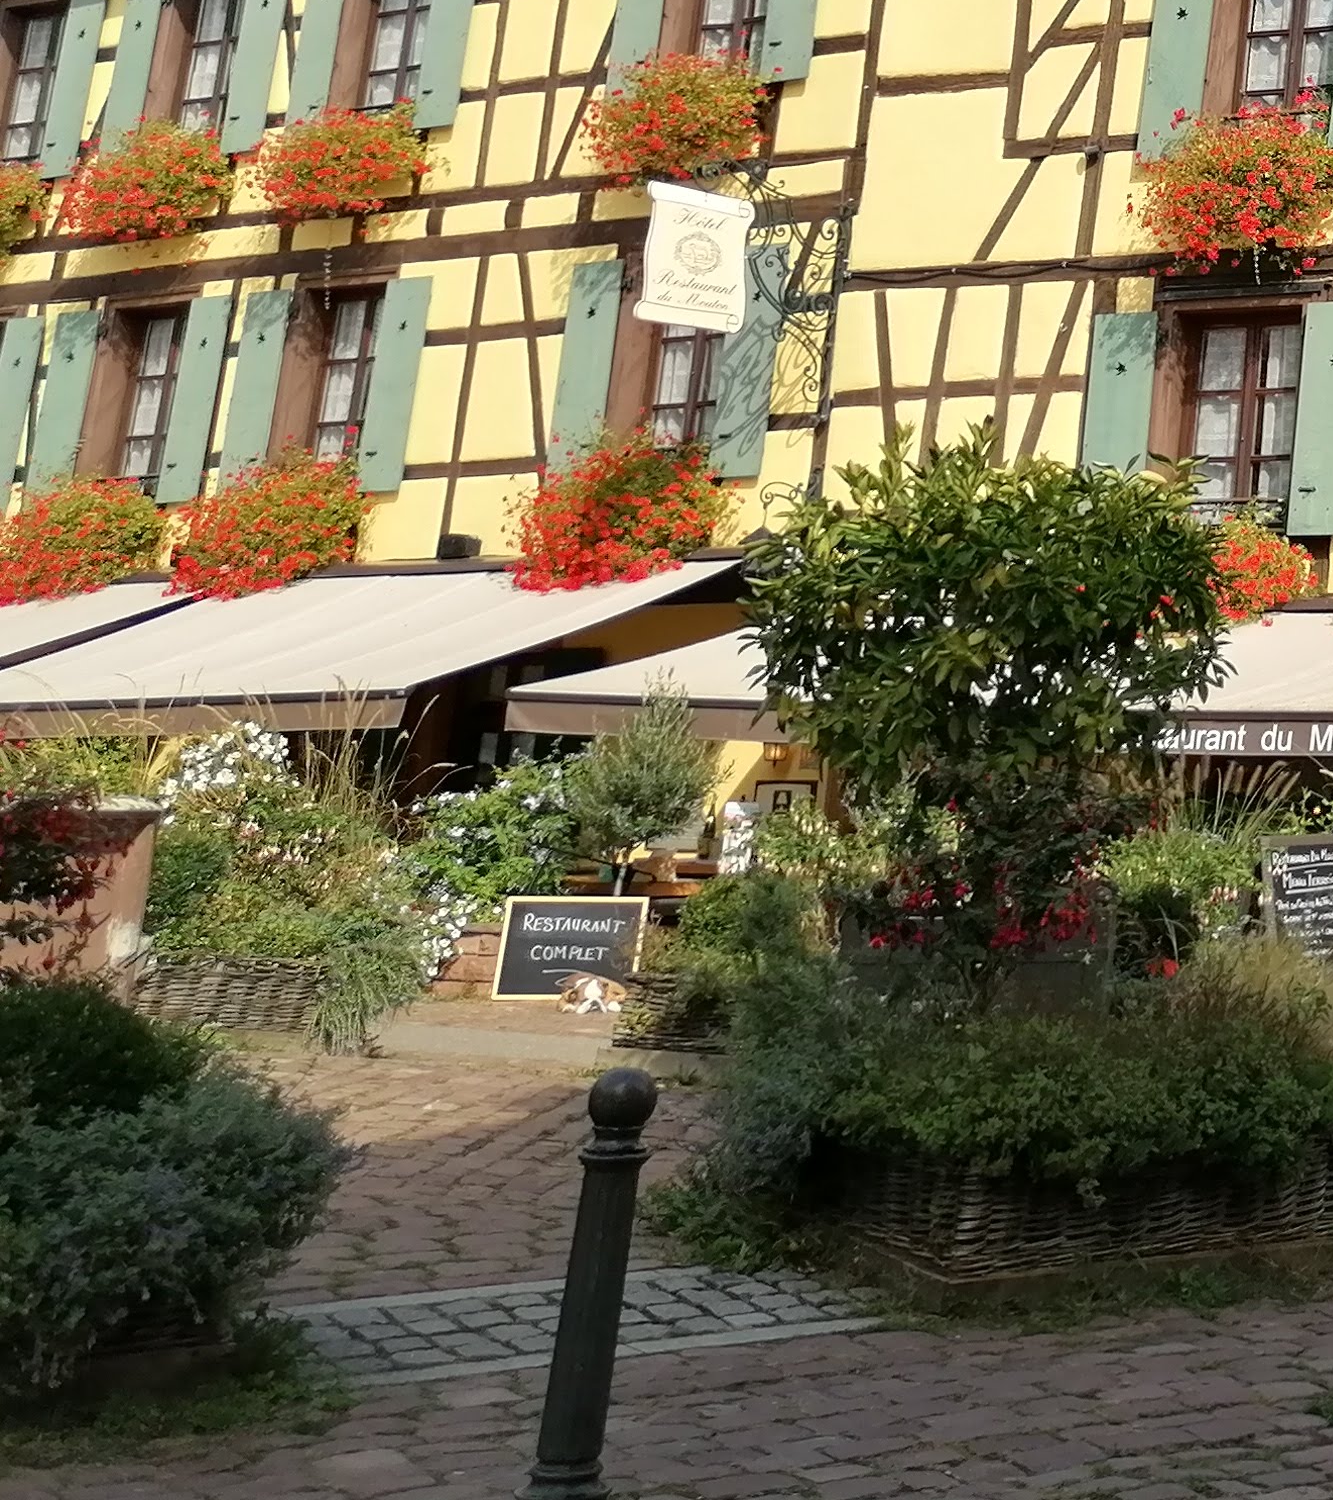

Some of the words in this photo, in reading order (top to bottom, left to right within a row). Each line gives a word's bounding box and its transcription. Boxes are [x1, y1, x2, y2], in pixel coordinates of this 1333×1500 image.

[674, 207, 729, 230] Hôtel
[653, 268, 737, 295] Restaurant
[657, 290, 672, 302] du
[677, 293, 729, 310] Mouton
[1260, 723, 1293, 752] du
[522, 912, 626, 934] RESTAURANT
[529, 944, 610, 961] COMPLET
